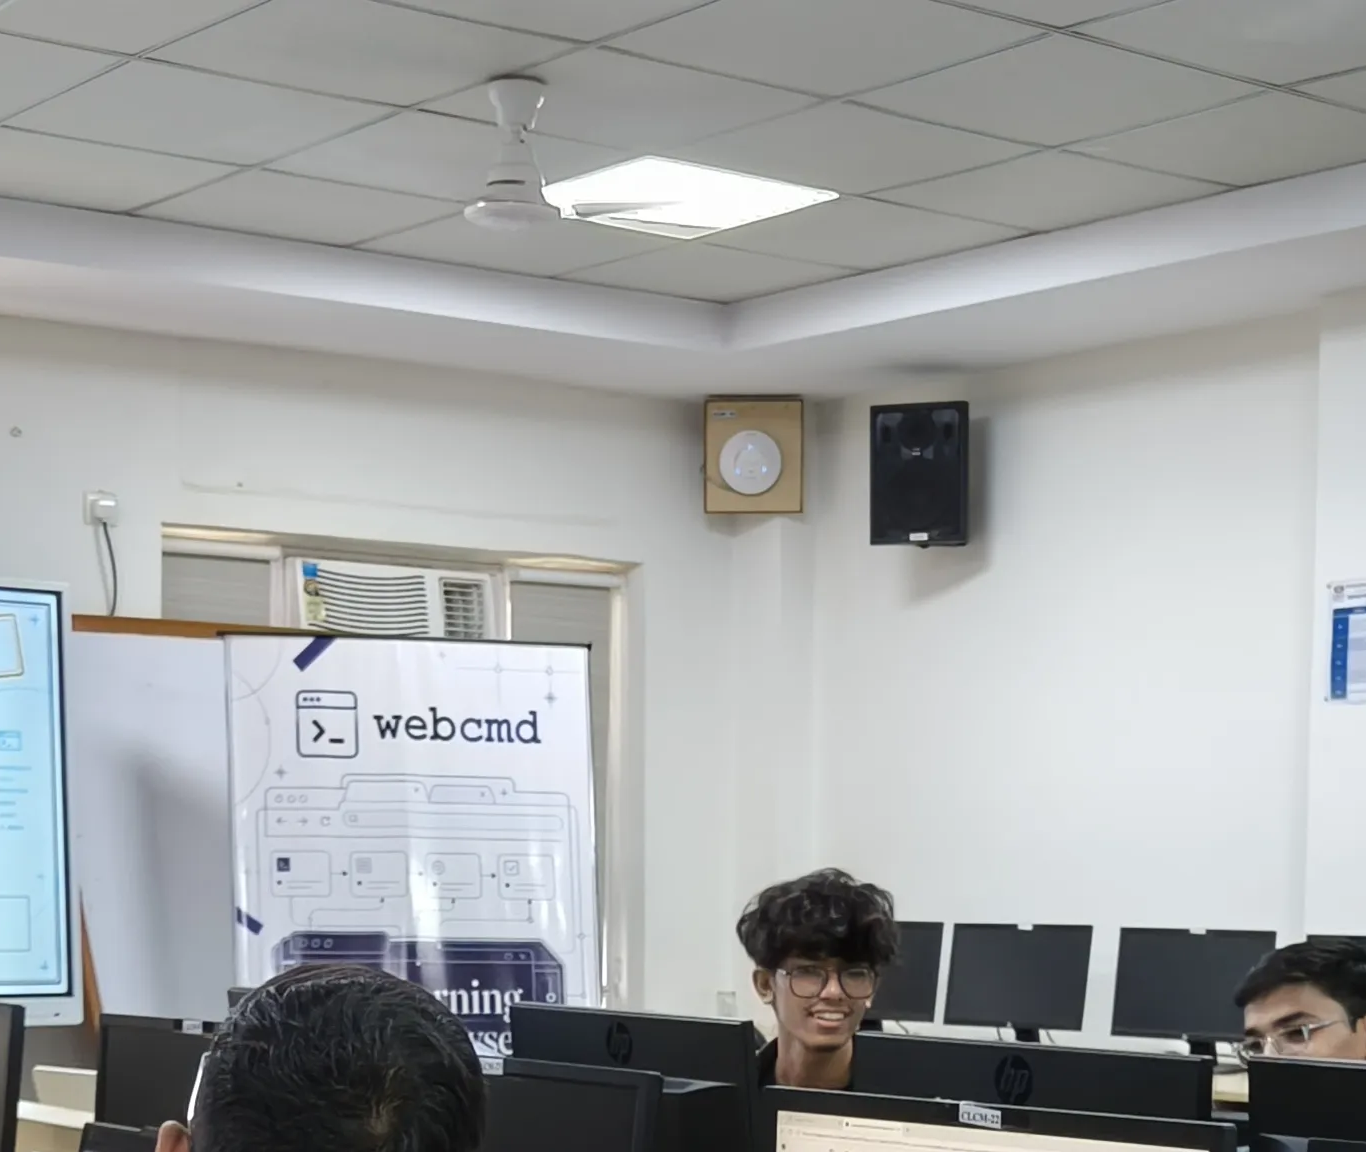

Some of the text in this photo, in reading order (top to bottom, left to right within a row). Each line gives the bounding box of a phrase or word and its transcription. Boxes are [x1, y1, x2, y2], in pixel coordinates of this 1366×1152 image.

[373, 706, 542, 744] webcmd
[997, 1054, 1032, 1105] hp
[961, 1111, 1000, 1125] CLCM-22
